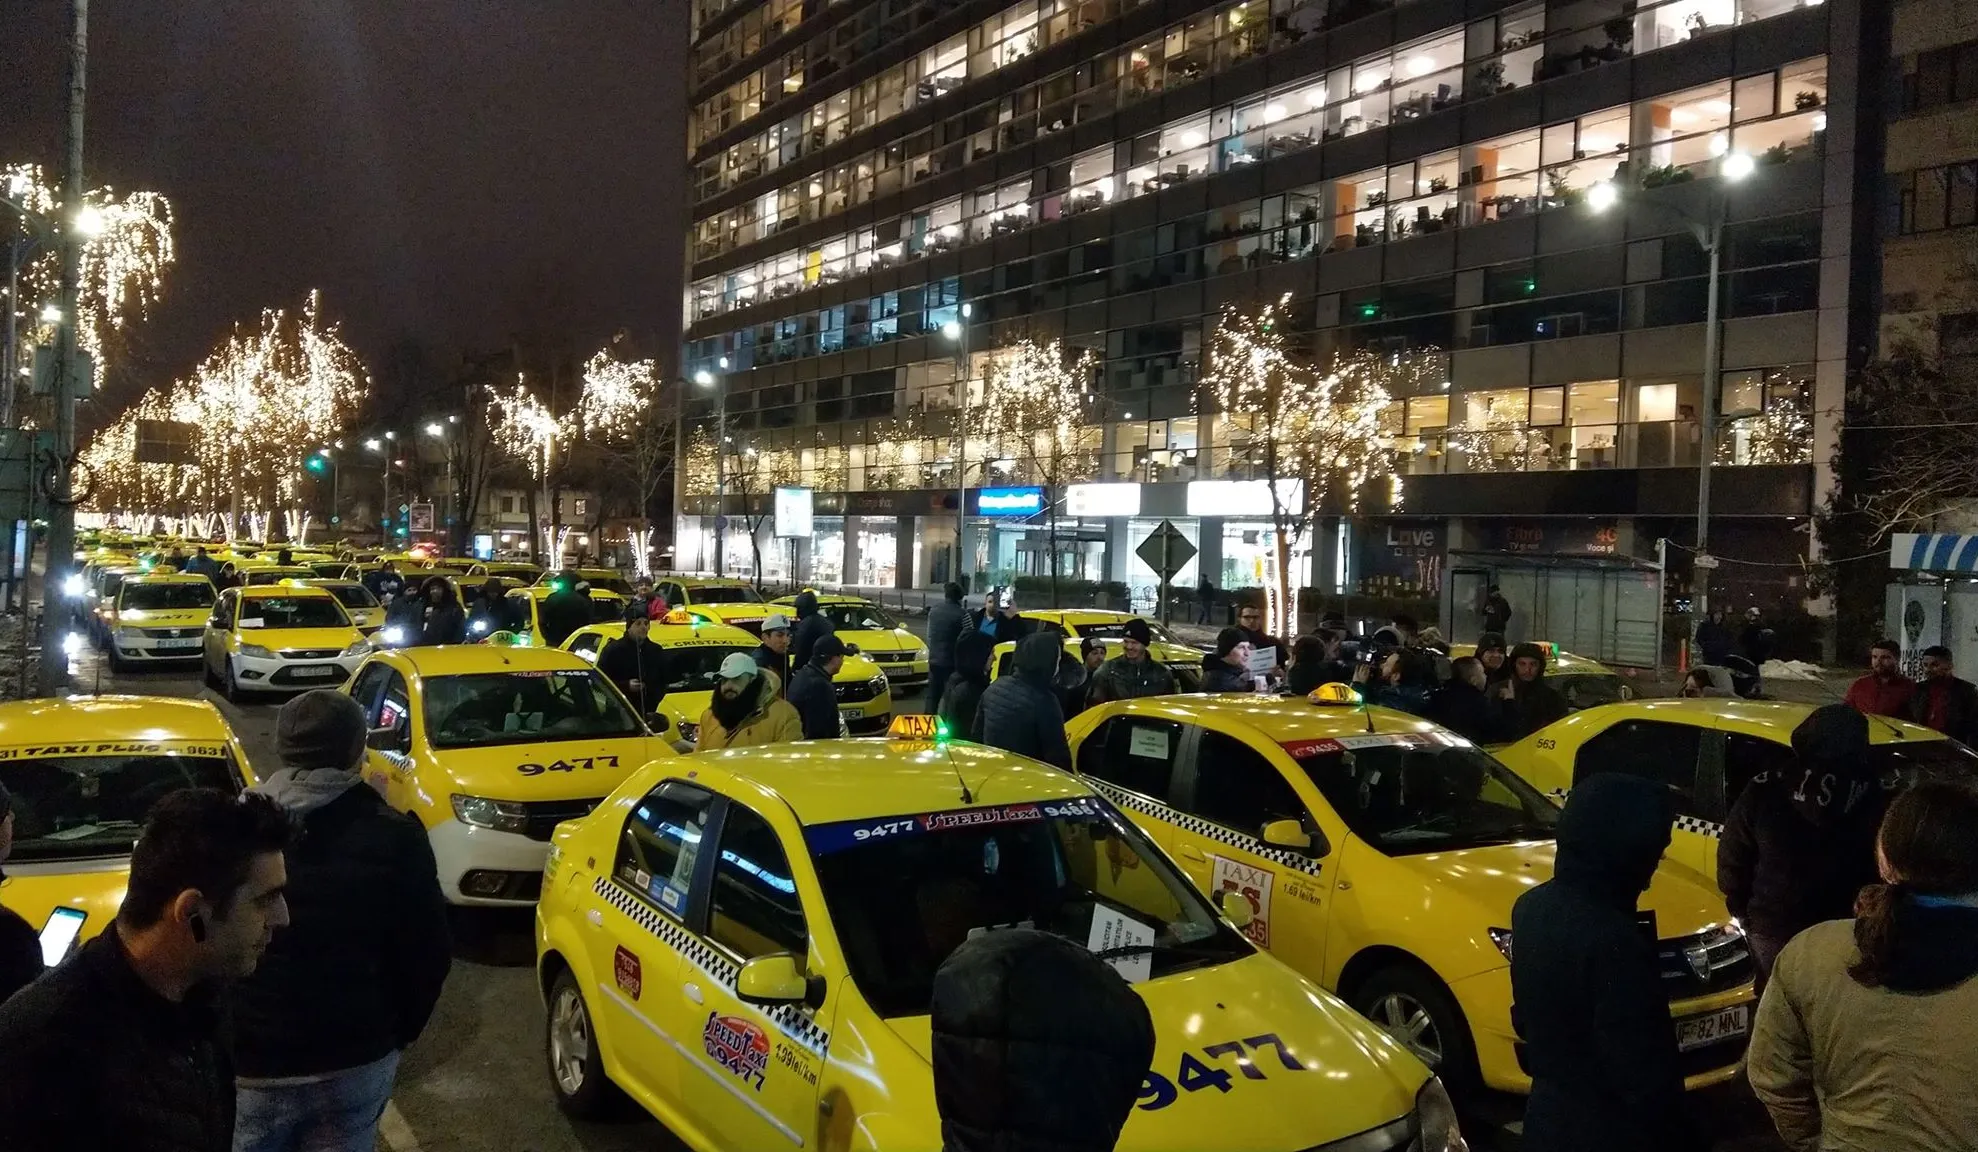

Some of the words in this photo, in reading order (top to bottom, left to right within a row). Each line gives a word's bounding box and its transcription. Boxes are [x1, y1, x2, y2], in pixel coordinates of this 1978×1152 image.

[674, 639, 733, 647] CRISTAXI
[904, 716, 937, 736] TAXI
[24, 744, 90, 755] TAXI
[1306, 743, 1340, 755] 9435
[1536, 738, 1556, 750] 563
[517, 756, 619, 776] 9477
[853, 820, 914, 840] 9477
[1043, 803, 1096, 818] 9488
[1222, 862, 1267, 889] TAXI
[716, 1044, 766, 1092] 9477
[1136, 1033, 1308, 1112] 9477
